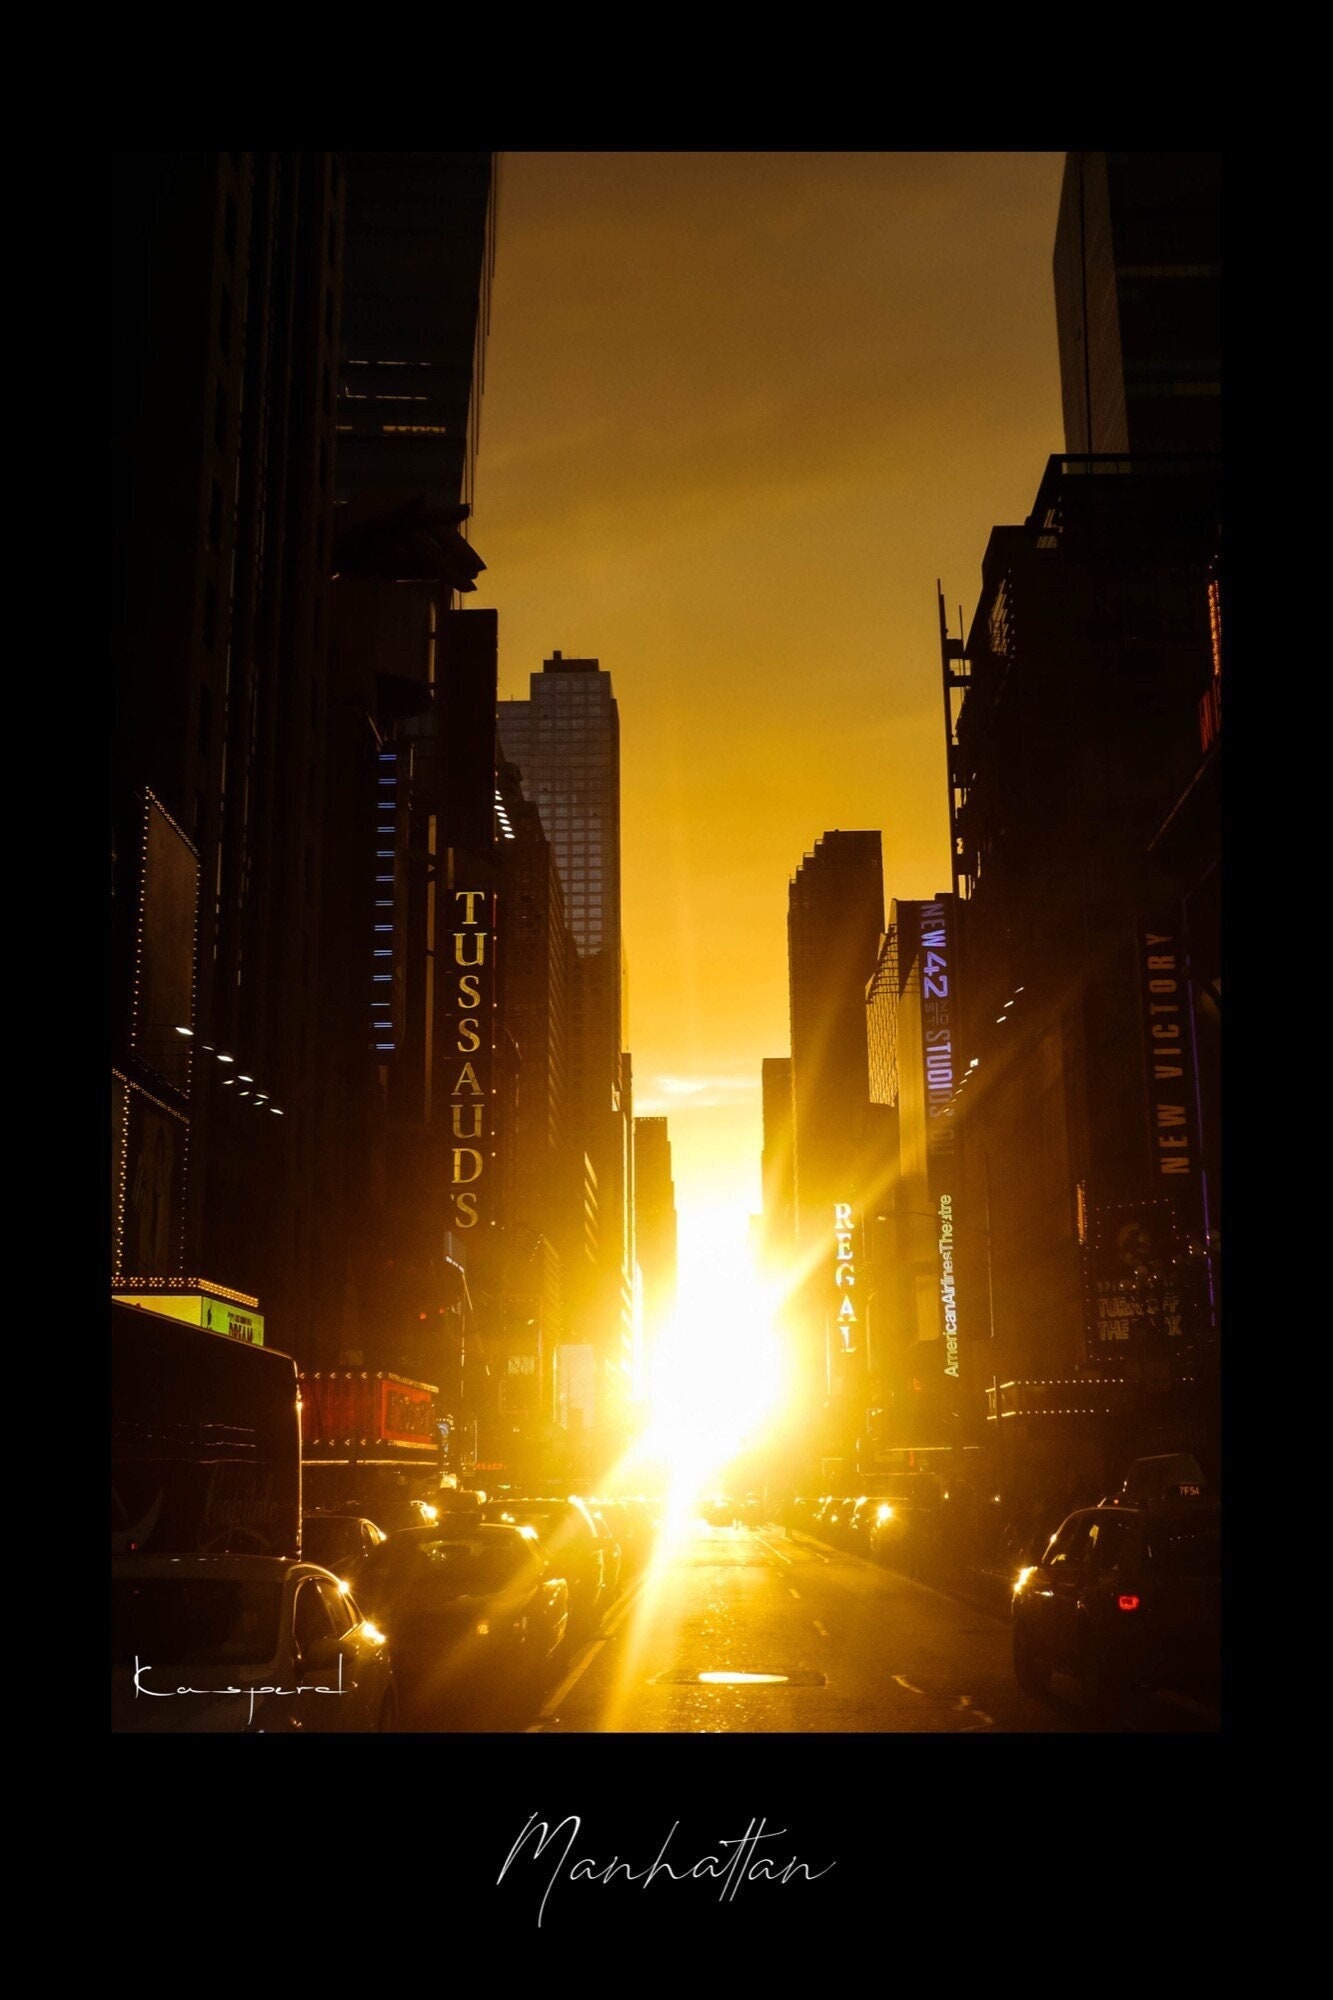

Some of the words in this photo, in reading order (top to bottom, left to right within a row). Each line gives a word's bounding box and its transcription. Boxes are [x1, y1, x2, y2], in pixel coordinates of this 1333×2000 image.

[920, 903, 946, 948] NEW
[923, 950, 949, 999] 42
[1144, 933, 1184, 1080] VICTORY
[450, 892, 487, 1228] TUSSAUD'S
[925, 1029, 954, 1118] STUDIOS
[1156, 1104, 1190, 1174] NEW
[834, 1203, 858, 1353] REGAL
[1097, 1319, 1129, 1340] THE
